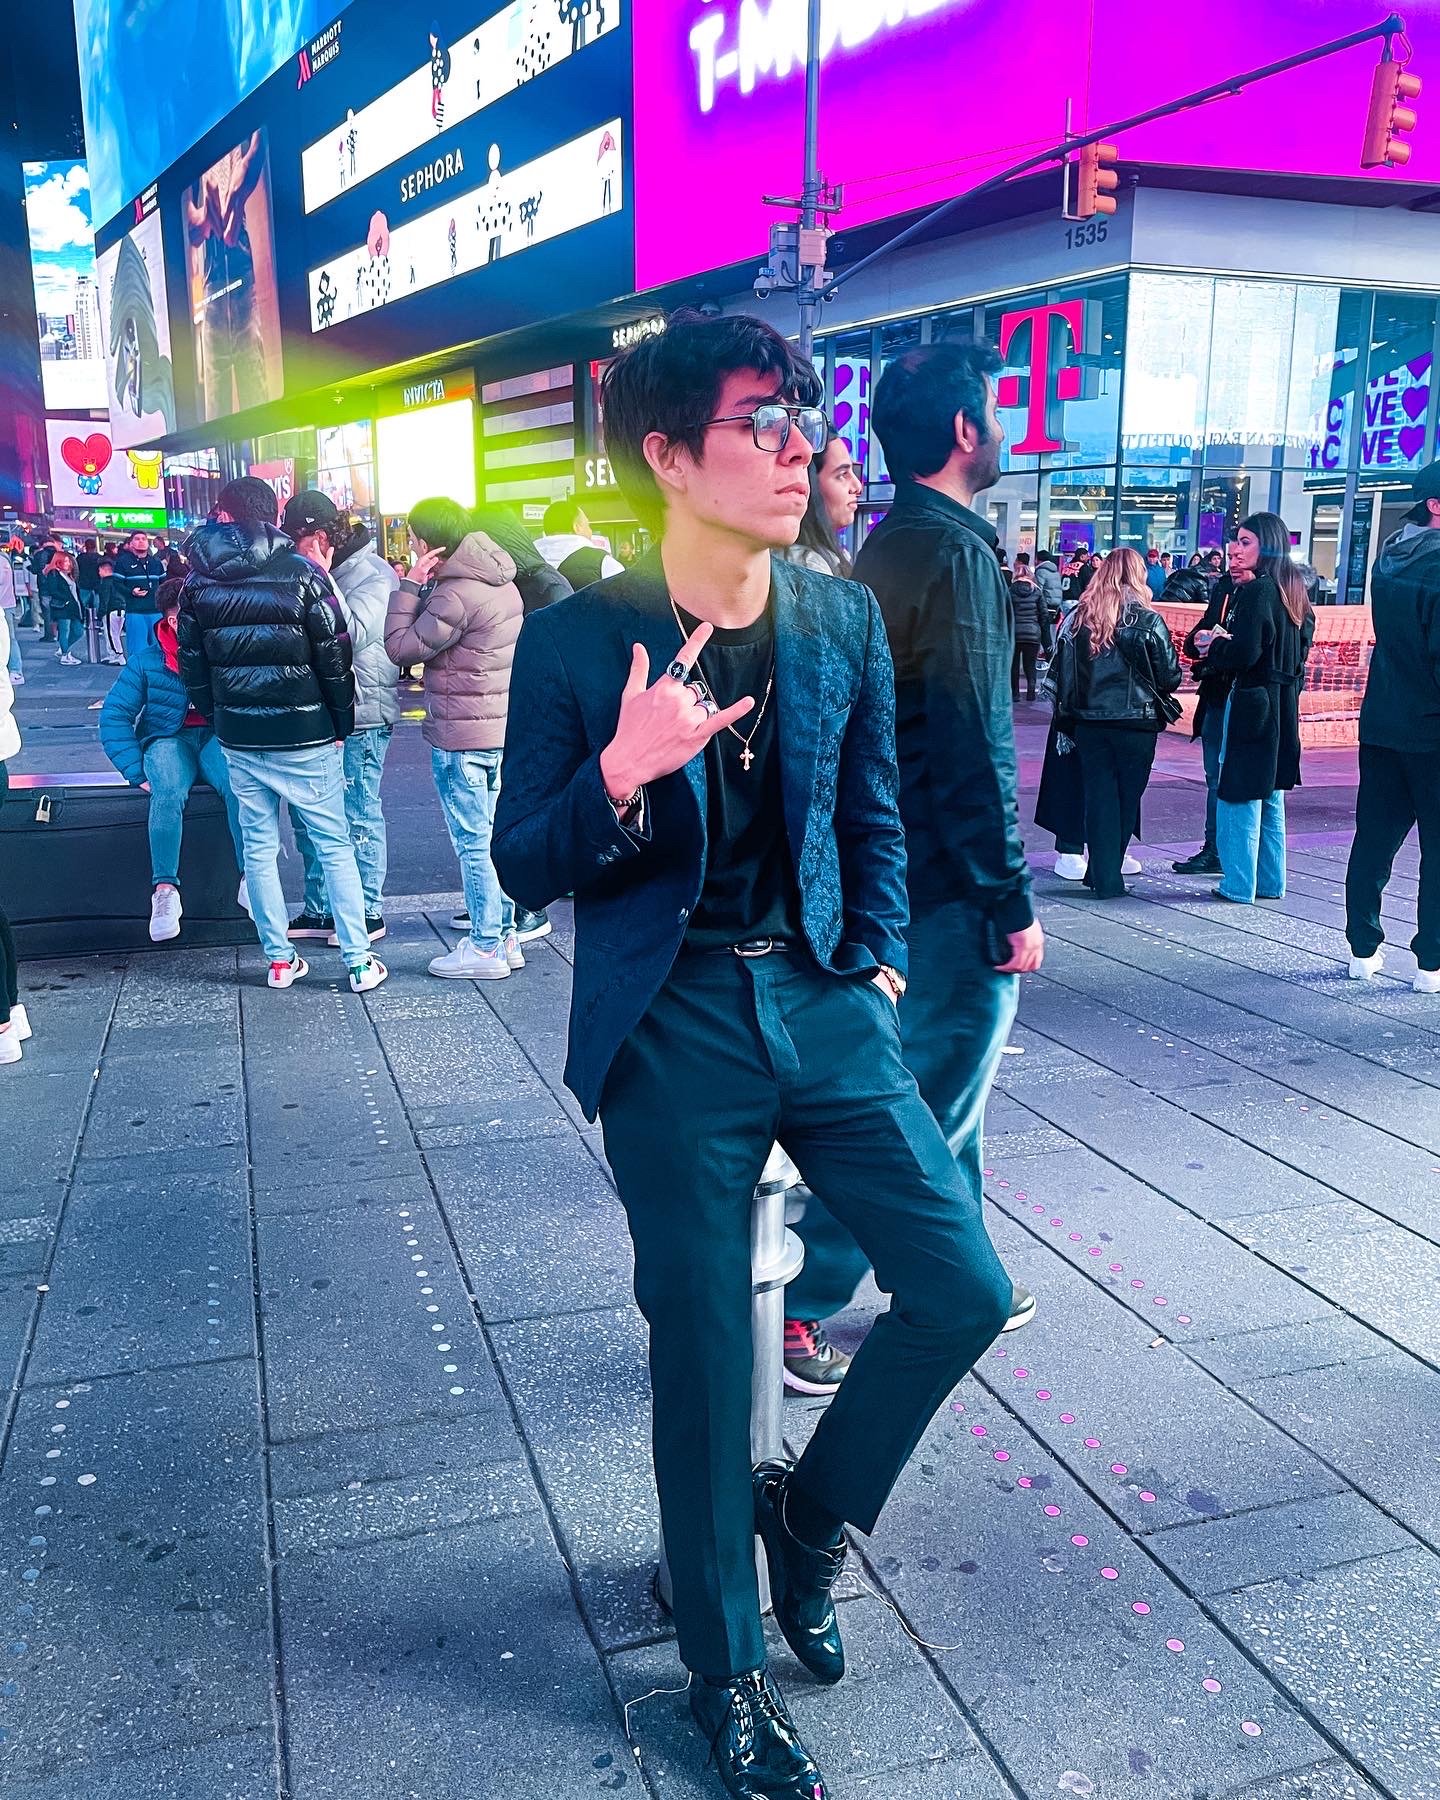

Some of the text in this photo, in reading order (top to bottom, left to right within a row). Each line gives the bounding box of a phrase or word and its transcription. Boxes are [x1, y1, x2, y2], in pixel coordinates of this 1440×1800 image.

[312, 41, 340, 73] MARQUIS
[401, 148, 464, 203] SEPHORA
[1065, 220, 1108, 250] 1535
[403, 379, 446, 408] INVICTA
